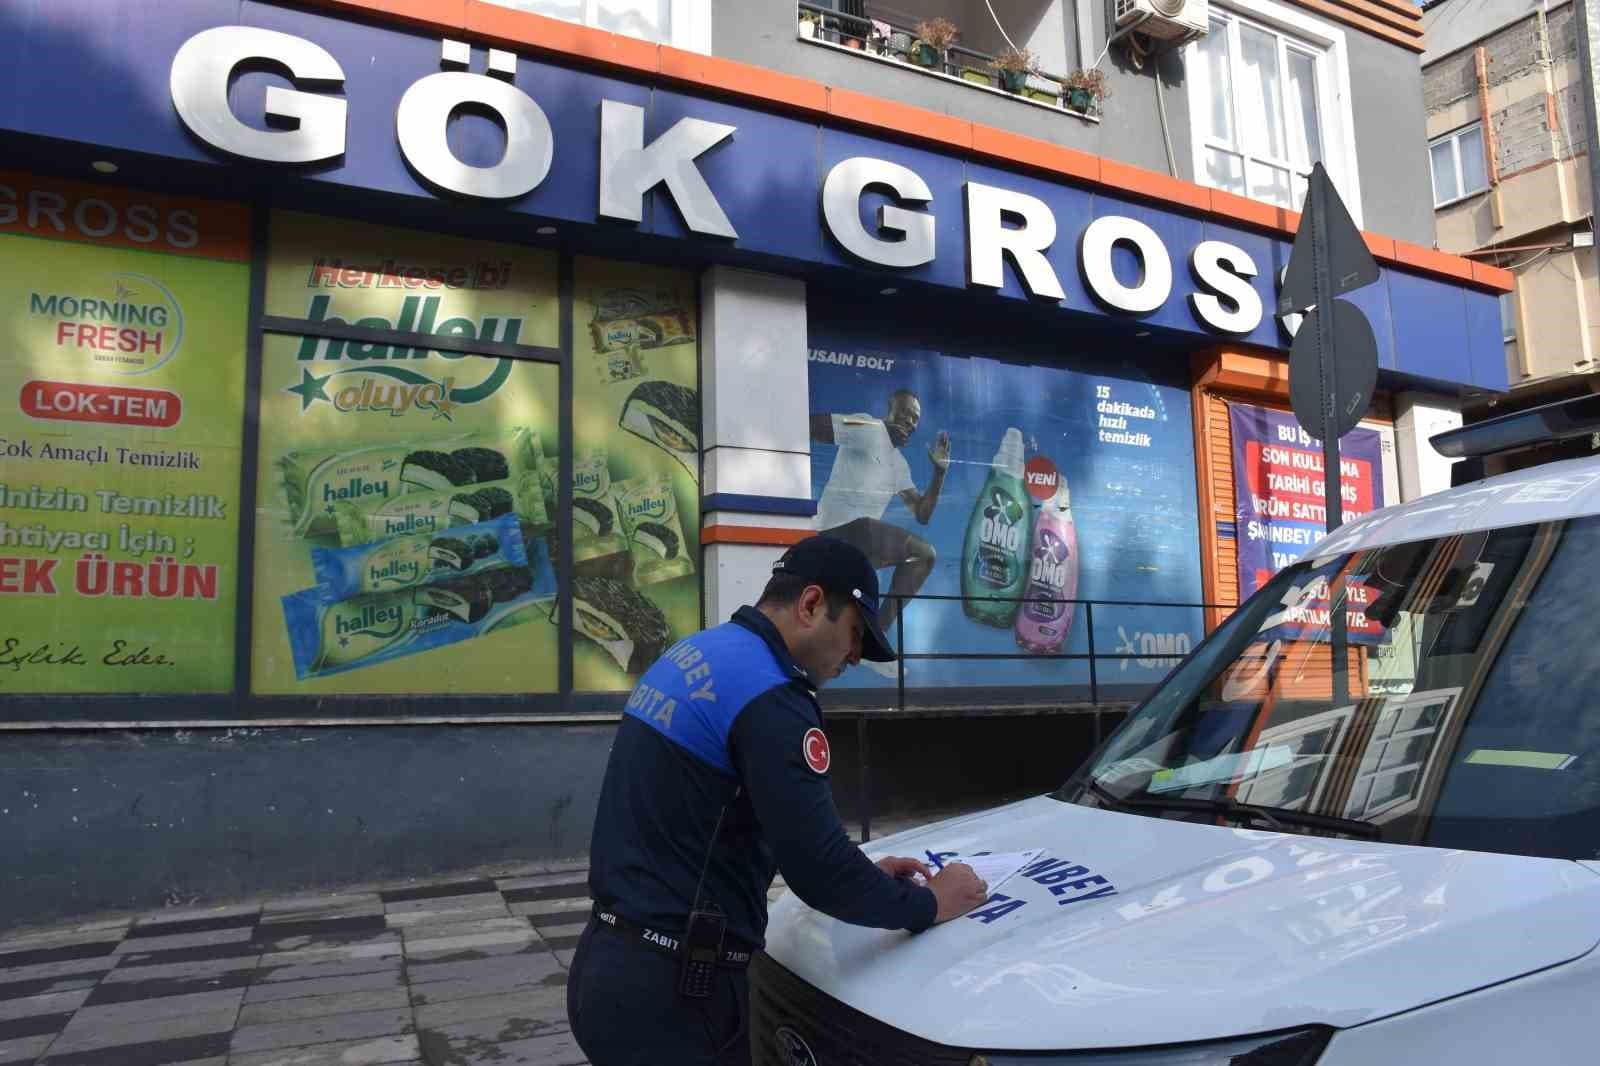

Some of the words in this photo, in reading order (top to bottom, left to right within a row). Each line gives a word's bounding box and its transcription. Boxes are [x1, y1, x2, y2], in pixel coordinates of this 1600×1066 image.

[169, 25, 739, 240] GÖK
[309, 257, 463, 289] Herkese
[30, 292, 168, 328] MORNING
[57, 321, 163, 355] FRESH
[807, 348, 854, 366] USAIN
[856, 355, 894, 371] BOLT
[35, 389, 168, 420] LOK-TEM
[1096, 385, 1111, 399] 15
[1097, 400, 1156, 420] dakikada
[1099, 414, 1127, 430] hızlı
[1099, 430, 1152, 447] temizlik
[1278, 425, 1296, 441] BU
[39, 443, 109, 466] Amaçlı
[116, 447, 200, 470] Temizlik
[1262, 448, 1290, 466] SON
[1292, 452, 1359, 478] KULLMA
[324, 478, 388, 502] halley
[1027, 471, 1057, 486] YENİ
[1267, 473, 1310, 495] TARİHİ
[96, 490, 226, 519] Temizlik
[385, 513, 436, 535] halley
[120, 523, 176, 557] İçin
[75, 553, 217, 599] ÜRÜN
[369, 560, 419, 584] halley
[1308, 580, 1368, 603] SÜYLE
[335, 603, 403, 638] halley
[103, 639, 175, 666] Eder.
[1140, 632, 1190, 669] OMO
